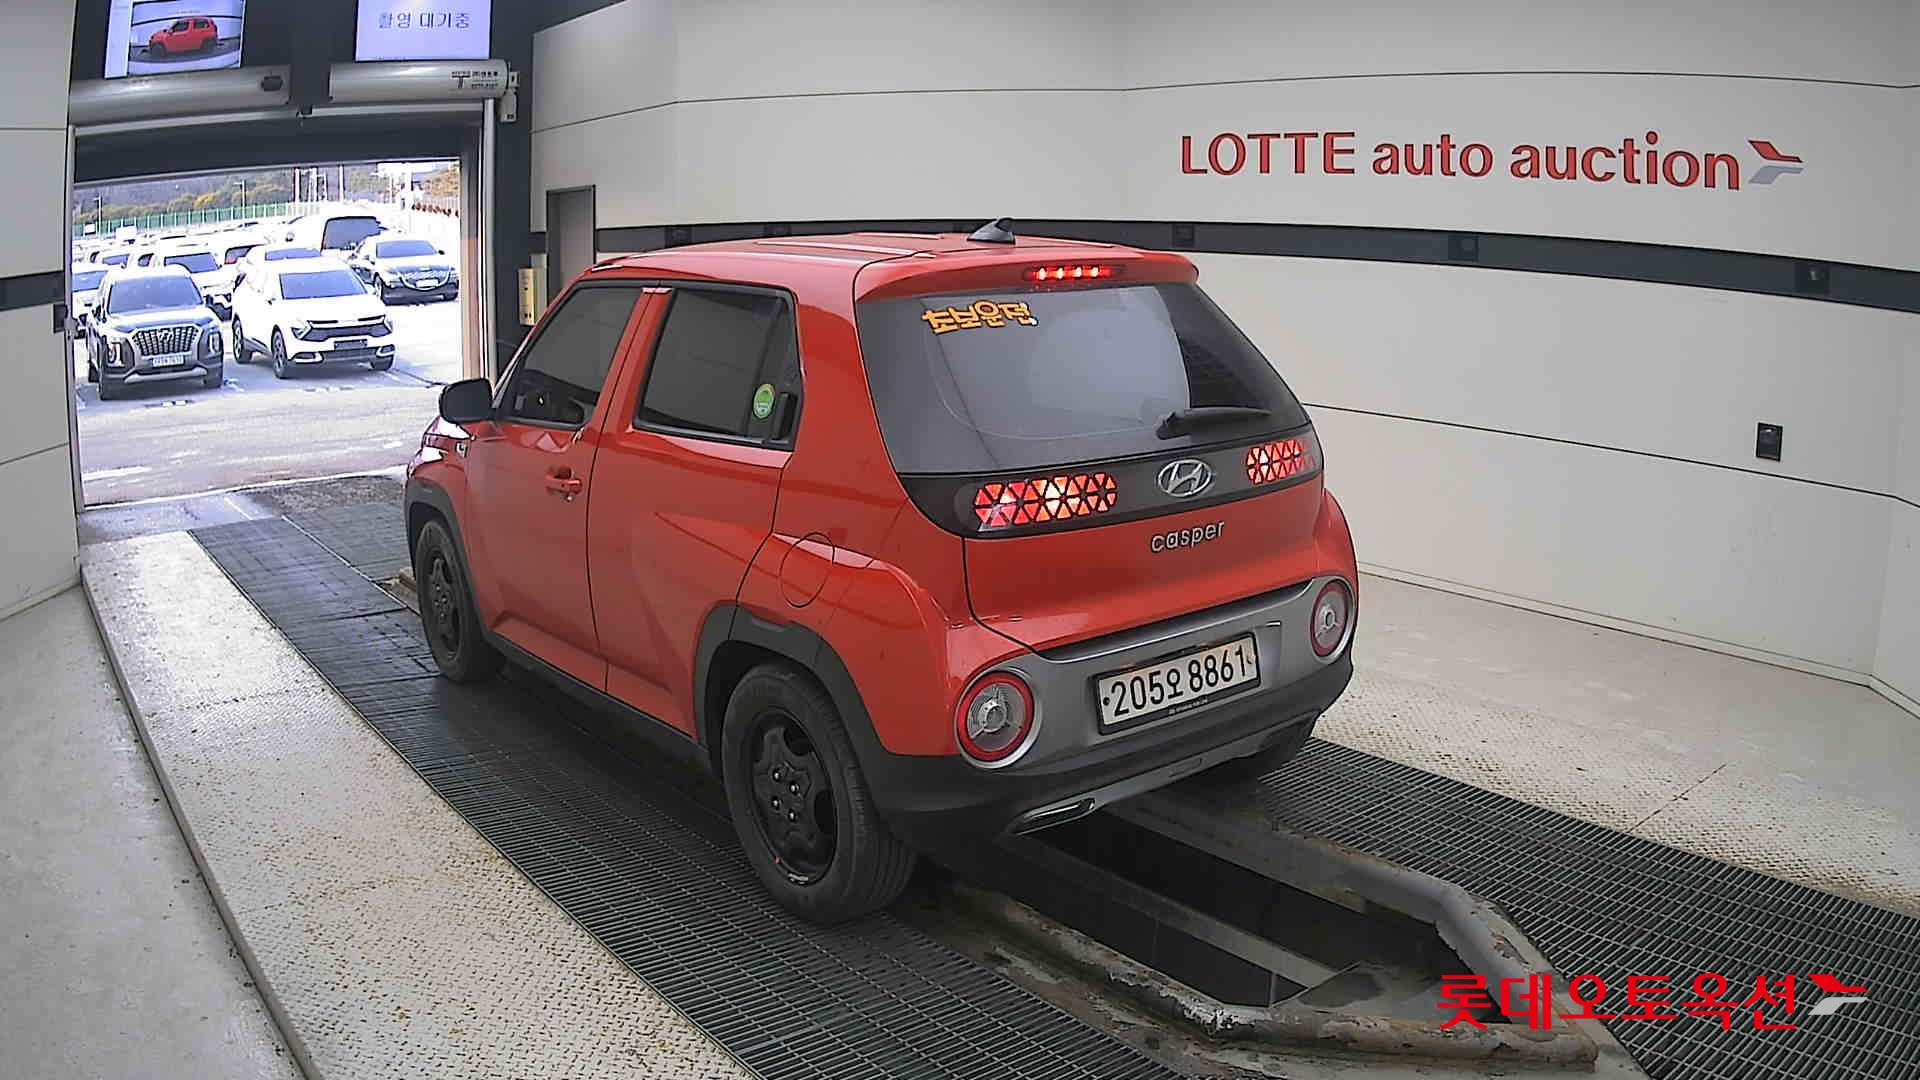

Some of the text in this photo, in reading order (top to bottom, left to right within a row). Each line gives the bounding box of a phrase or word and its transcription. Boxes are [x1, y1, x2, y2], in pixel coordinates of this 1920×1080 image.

[419, 11, 470, 30] 대기중
[1181, 130, 1741, 191] LOTTE auto auction
[922, 299, 1039, 335] 초보운전
[1151, 520, 1225, 553] casper
[1111, 644, 1246, 717] 205오 8861
